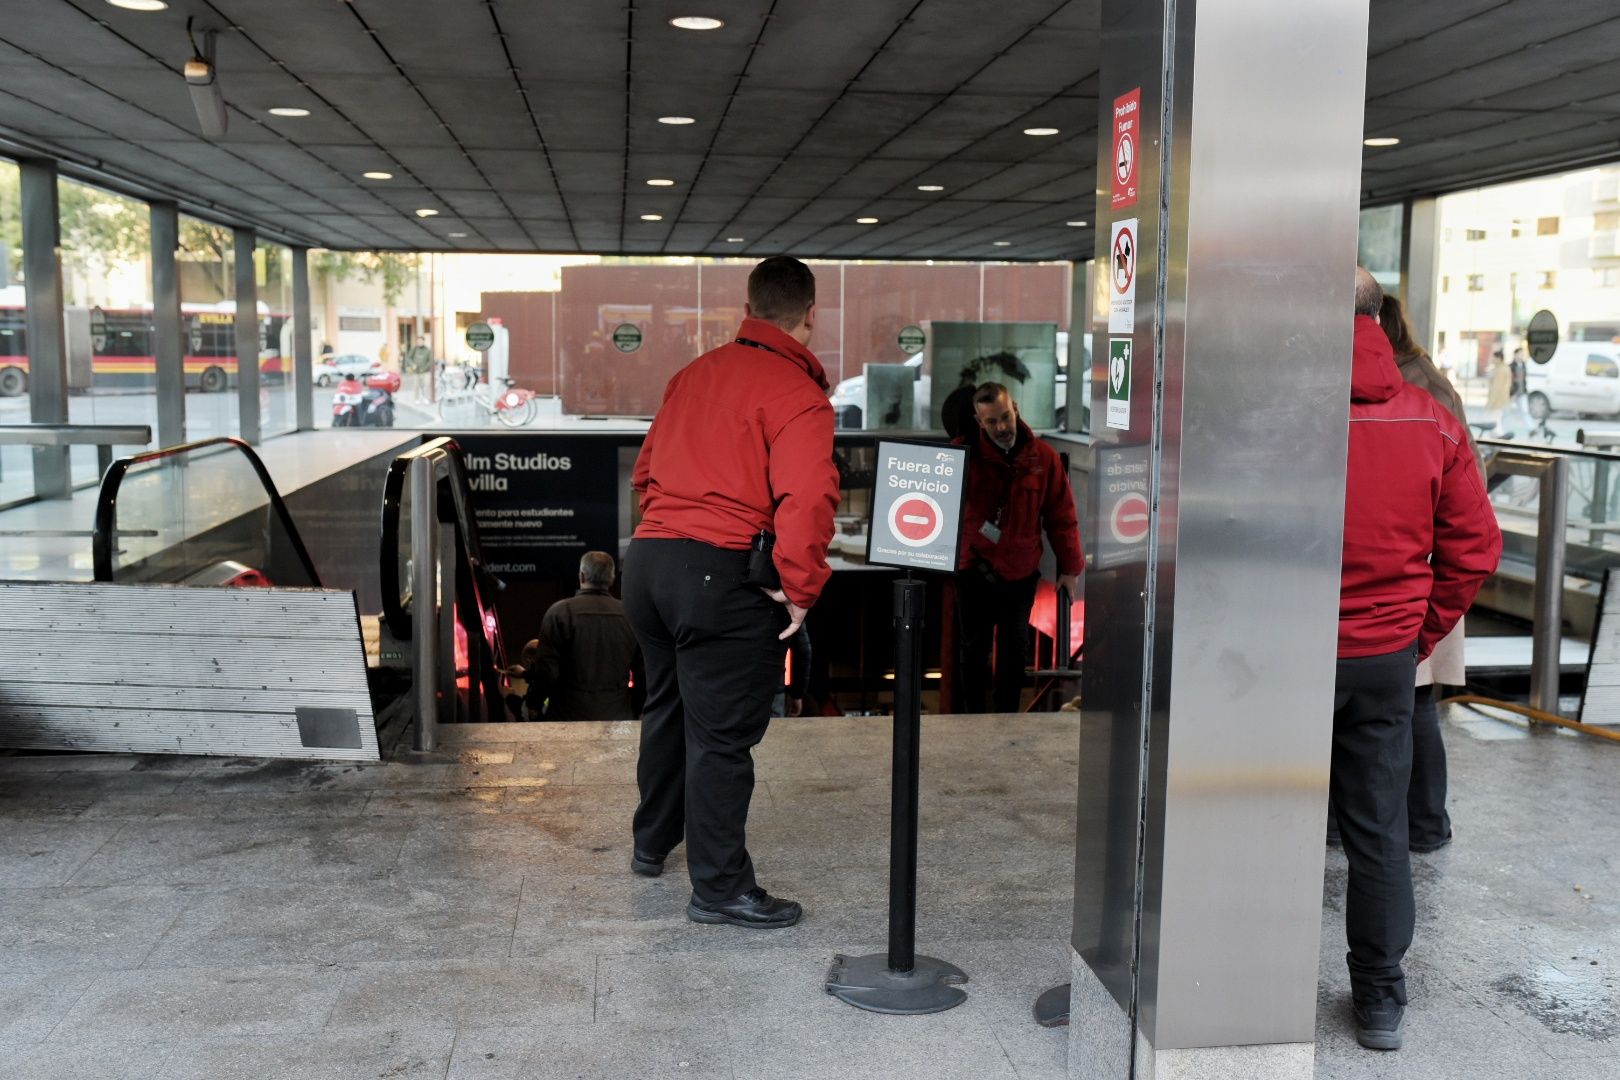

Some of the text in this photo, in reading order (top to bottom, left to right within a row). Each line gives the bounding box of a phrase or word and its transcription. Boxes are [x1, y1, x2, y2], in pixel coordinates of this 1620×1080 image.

[464, 452, 572, 471] lm Studios
[887, 456, 954, 476] Fuera de
[468, 473, 508, 491] villa
[888, 475, 950, 493] Servicio
[520, 507, 574, 517] estudiantes
[514, 520, 543, 528] nuevo
